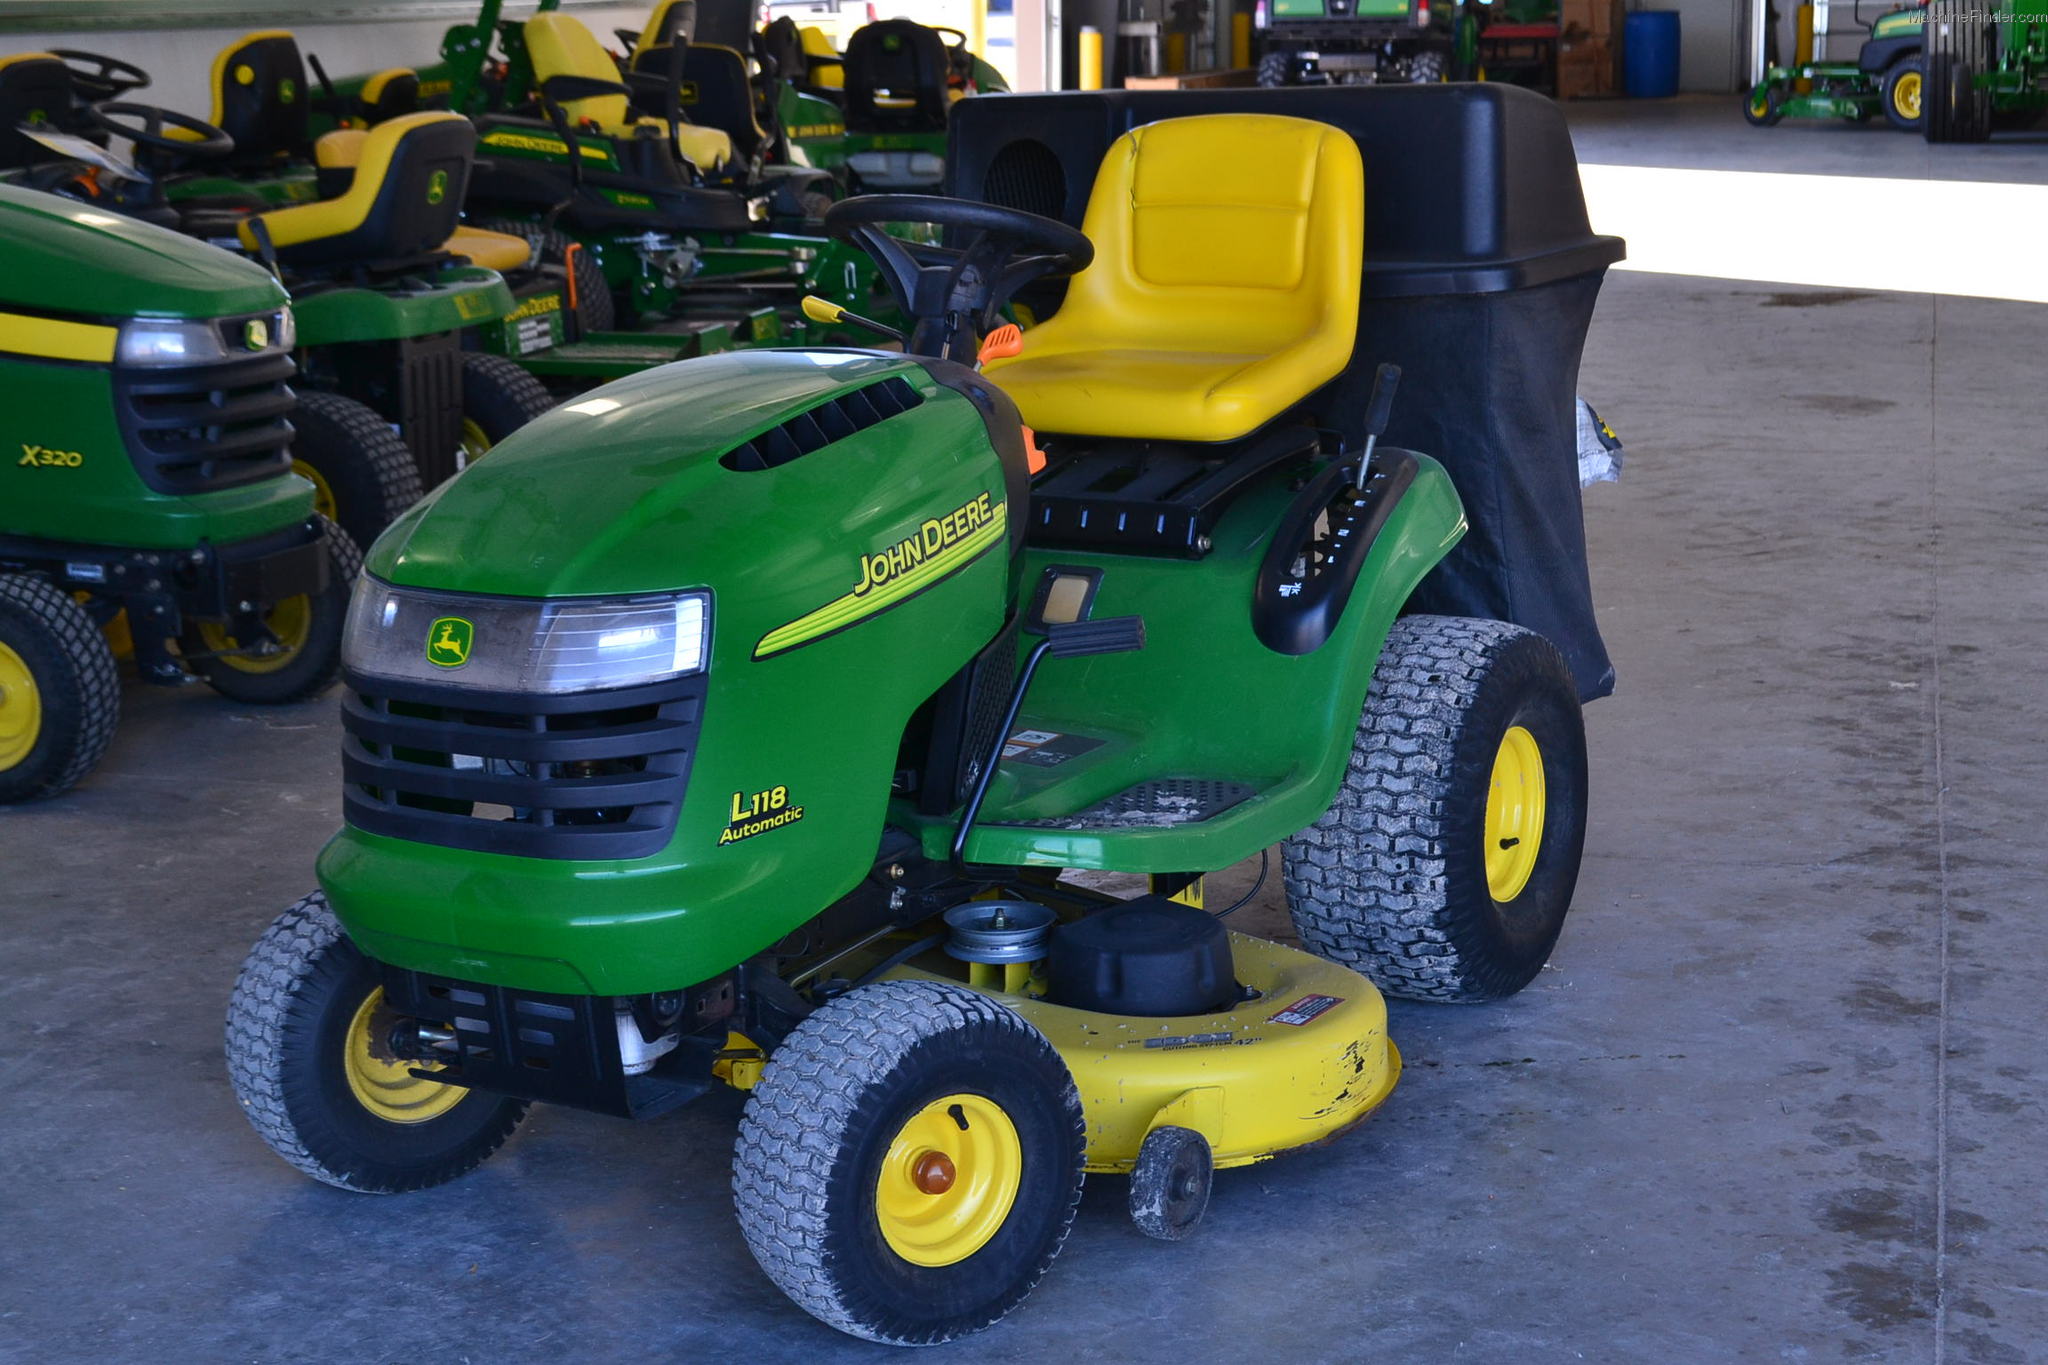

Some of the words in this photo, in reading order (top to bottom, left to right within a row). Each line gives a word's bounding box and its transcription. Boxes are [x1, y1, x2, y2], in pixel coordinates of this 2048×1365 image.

[497, 135, 524, 148] JOHN
[526, 139, 564, 153] DEERE
[528, 294, 560, 315] DEERE
[18, 443, 83, 467] X320
[853, 532, 924, 596] JOHN
[921, 490, 993, 559] DEERE
[731, 785, 787, 822] L118
[719, 806, 803, 845] Automatic
